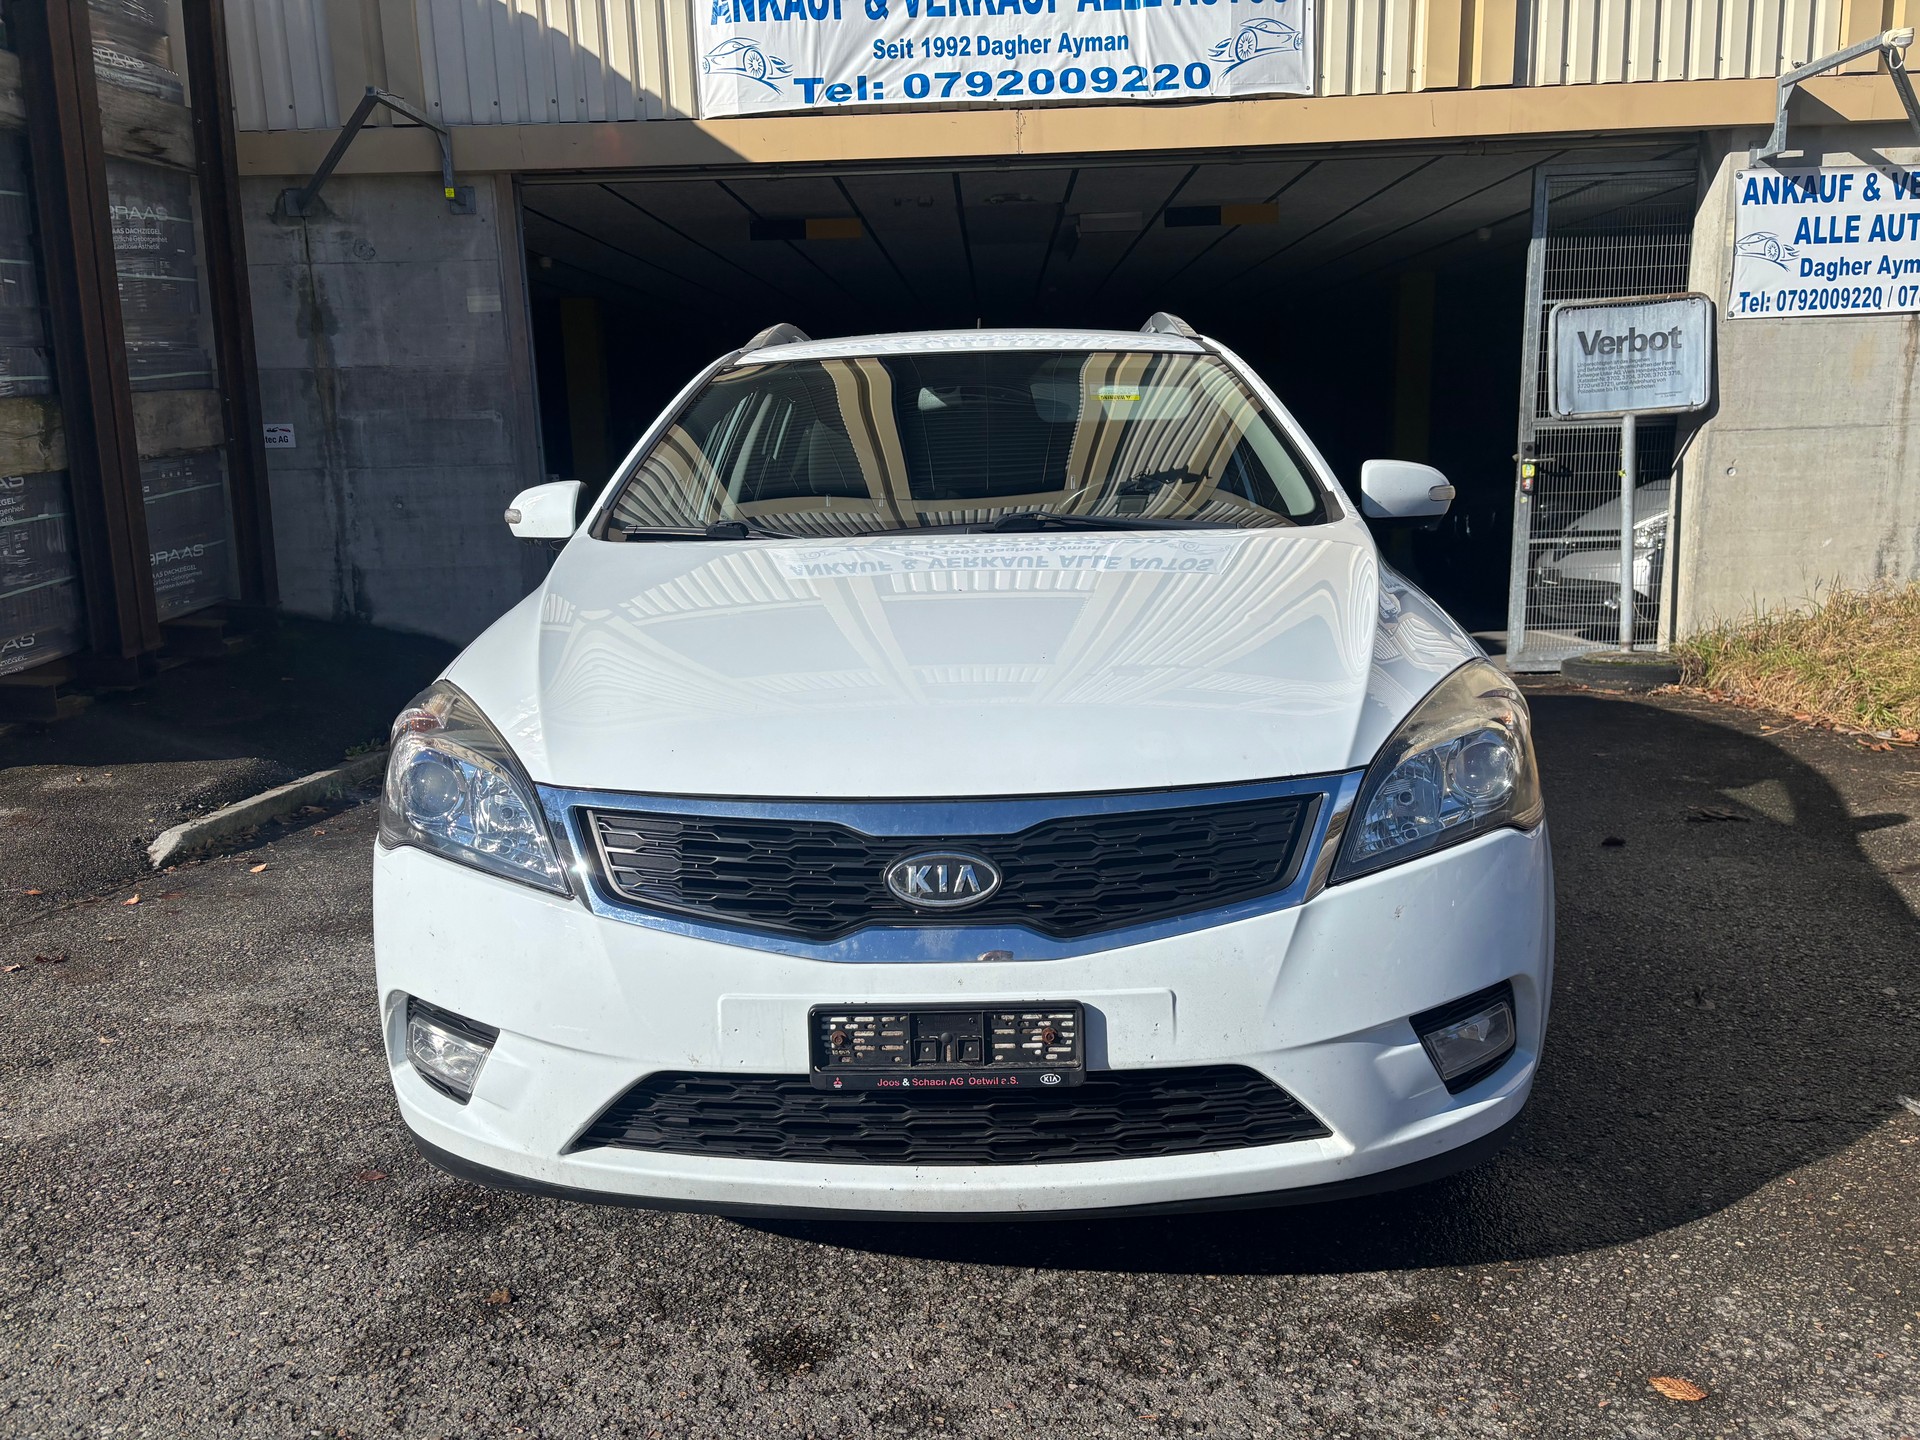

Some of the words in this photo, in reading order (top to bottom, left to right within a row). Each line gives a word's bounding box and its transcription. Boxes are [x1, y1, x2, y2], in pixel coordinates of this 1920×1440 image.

[873, 38, 914, 59] Seit
[921, 36, 971, 58] 1992
[977, 35, 1052, 60] Dagher
[1058, 32, 1129, 60] Ayman
[793, 75, 884, 104] Tel:
[903, 62, 1211, 99] 0792009220
[1742, 173, 1854, 205] ANKAUF
[1862, 172, 1882, 202] &
[1793, 215, 1861, 245] ALLE
[1868, 213, 1920, 242] AUT
[1800, 256, 1872, 282] Dagher
[1877, 255, 1920, 279] Aym
[1739, 291, 1770, 313] Tel:
[1776, 286, 1883, 312] 0792009220
[1887, 286, 1893, 308] /
[1898, 285, 1920, 306] 07
[1577, 325, 1682, 356] Verbot
[278, 435, 288, 443] AG
[907, 864, 981, 893] KIA
[877, 1078, 900, 1087] Joos
[902, 1078, 910, 1086] &
[949, 1077, 964, 1086] AG
[968, 1076, 999, 1085] Oetwil
